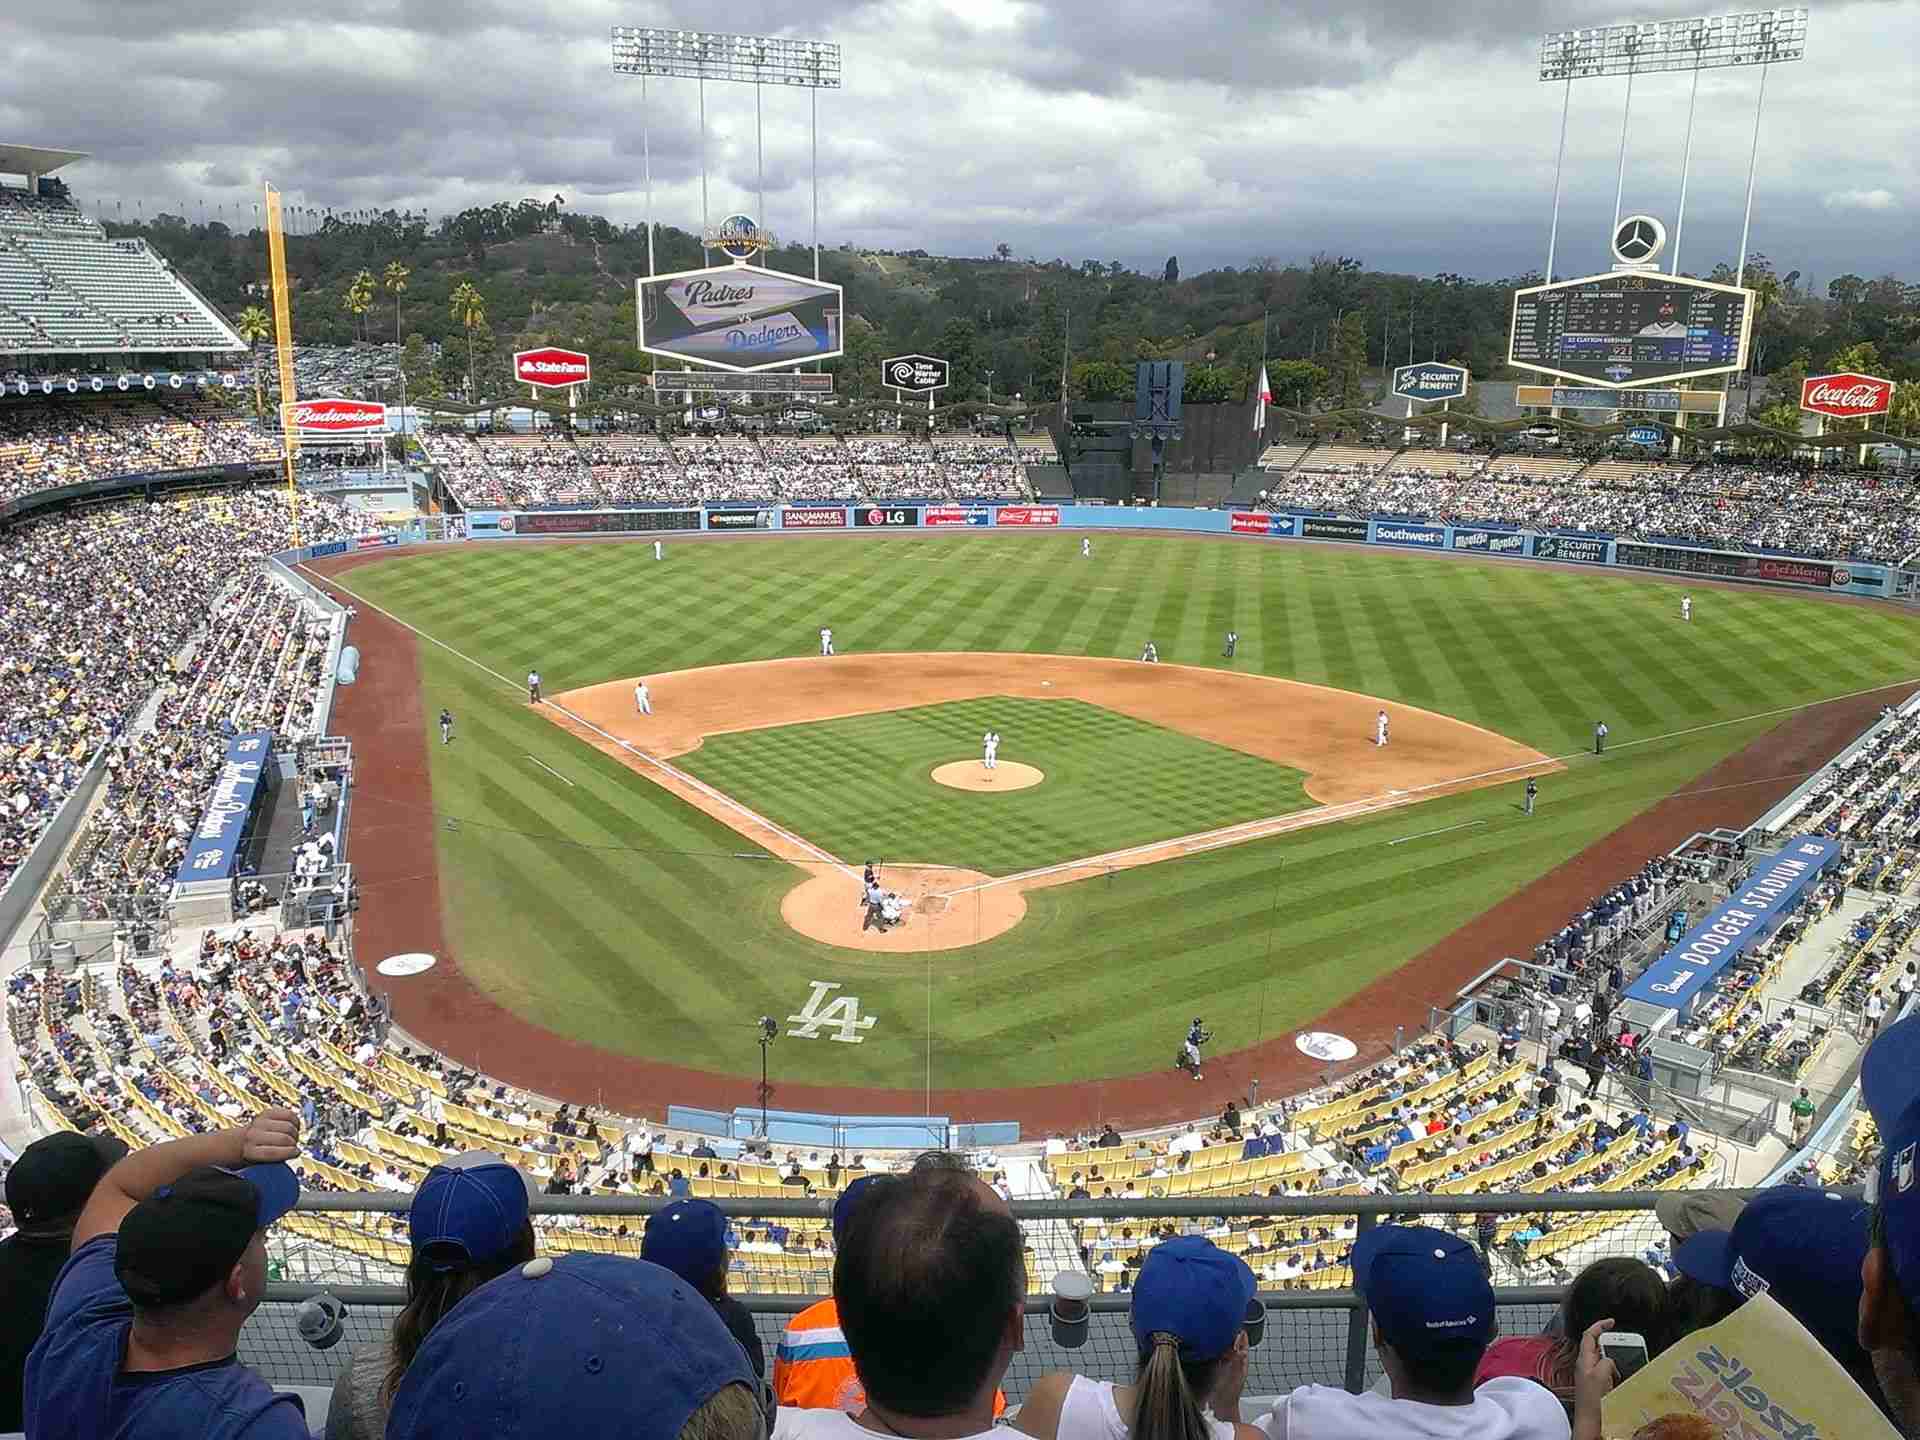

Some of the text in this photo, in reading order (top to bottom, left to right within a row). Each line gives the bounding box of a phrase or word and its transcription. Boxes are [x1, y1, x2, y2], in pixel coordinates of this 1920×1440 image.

[685, 280, 754, 307] Padres
[726, 324, 801, 347] Dodgers
[914, 362, 933, 370] Time
[1420, 372, 1460, 381] SECURITY
[1419, 382, 1456, 390] BENEFIT
[1808, 383, 1884, 408] Coca-Cola
[290, 407, 385, 425] Budweiser
[785, 511, 842, 521] SAN MANUEL
[886, 511, 905, 523] LG
[1377, 527, 1434, 543] Southwest
[1558, 540, 1603, 551] SECURITY
[1557, 550, 1597, 560] BENEFIT
[1680, 858, 1808, 966] DODGER STADIUM
[787, 981, 877, 1043] LA
